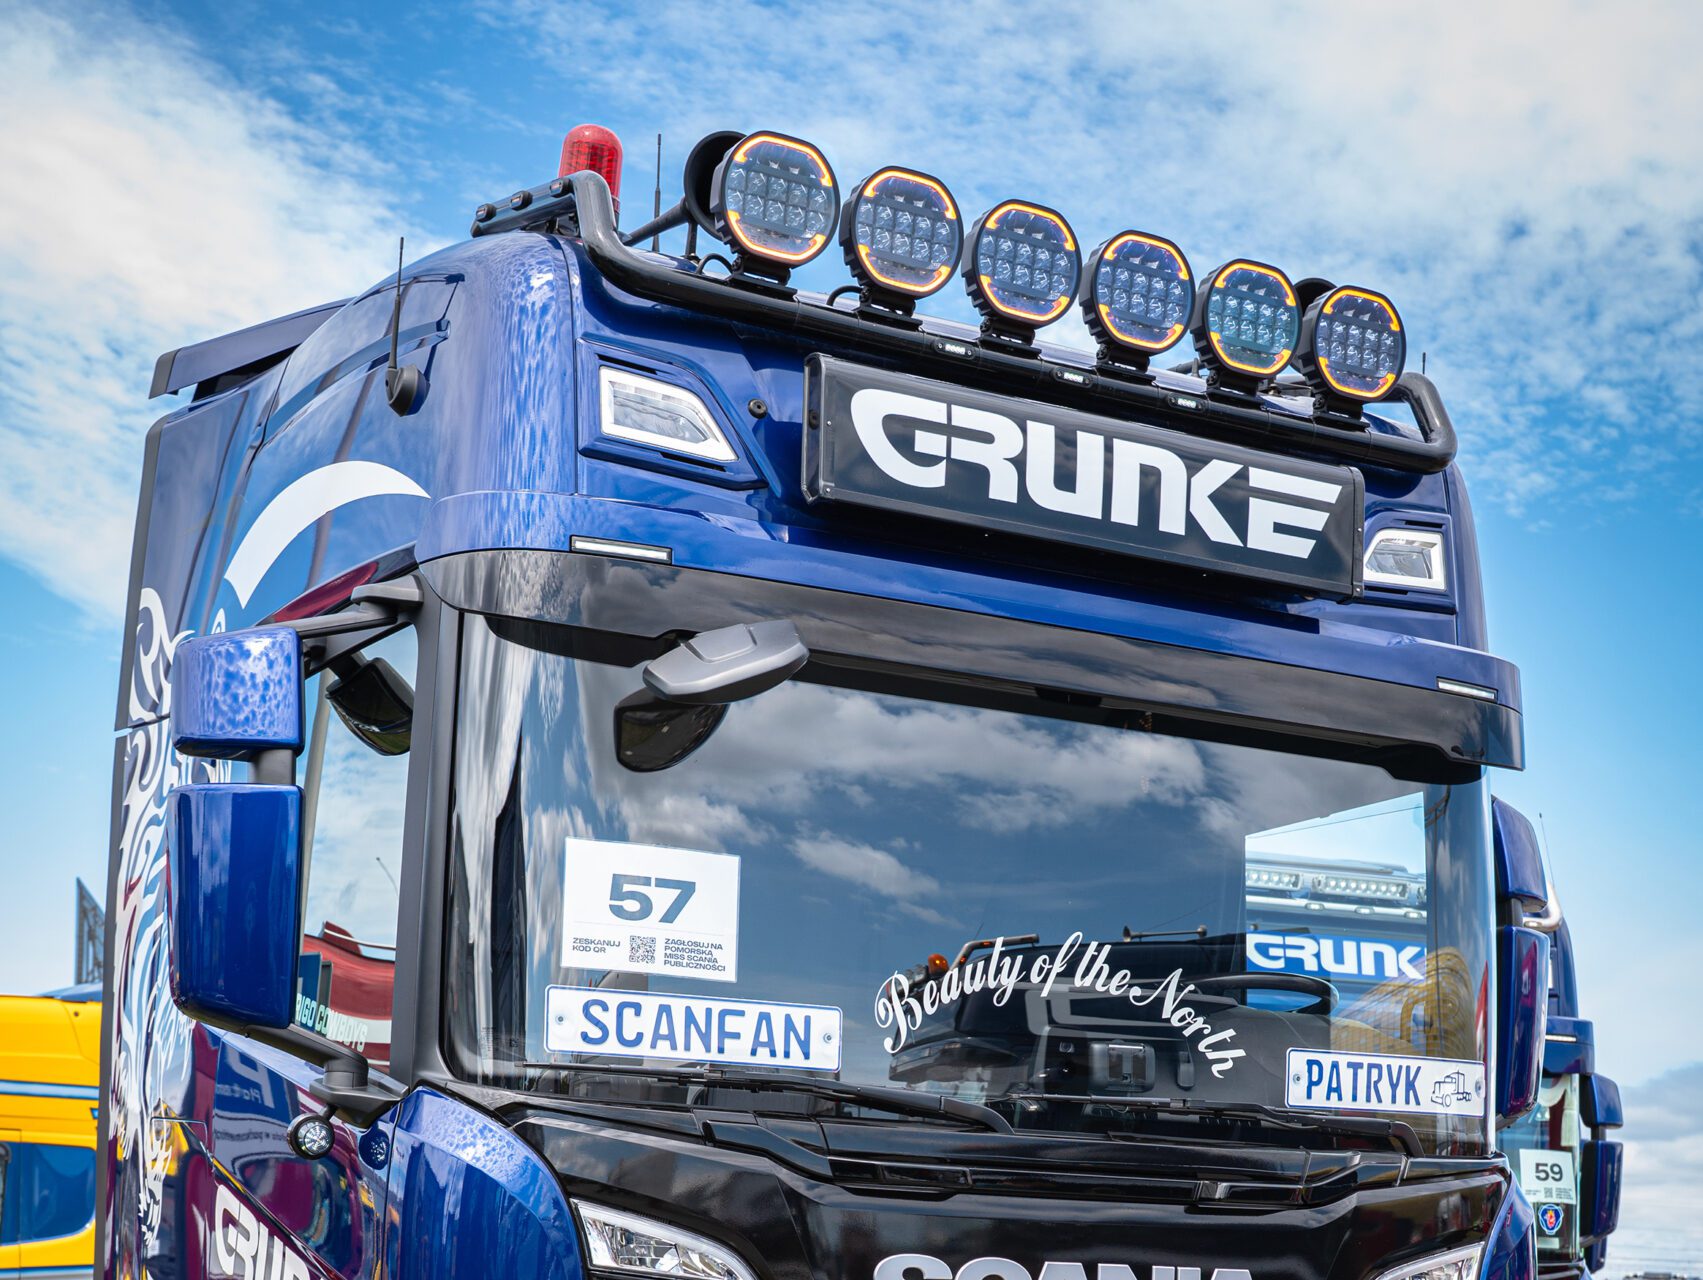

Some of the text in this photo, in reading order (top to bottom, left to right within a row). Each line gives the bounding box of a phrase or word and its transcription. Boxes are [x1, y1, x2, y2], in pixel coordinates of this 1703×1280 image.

[850, 388, 1342, 559] GRUNKE
[608, 873, 697, 924] 57
[572, 945, 591, 953] KOD
[573, 937, 621, 948] ZESKANUJ
[664, 945, 713, 957] POMORSKĄ
[664, 953, 718, 964] MISS SCANIA
[665, 938, 724, 951] ZAGŁOSUJ NA
[1246, 933, 1426, 979] GRUNK
[664, 959, 726, 972] PUBLICZNOŚCI
[874, 931, 1247, 1079] Beauty of the North
[295, 992, 368, 1052] RIGO COWBOYS
[580, 999, 812, 1060] SCANFAN
[1306, 1058, 1422, 1106] PATRYK
[1535, 1162, 1563, 1182] 59
